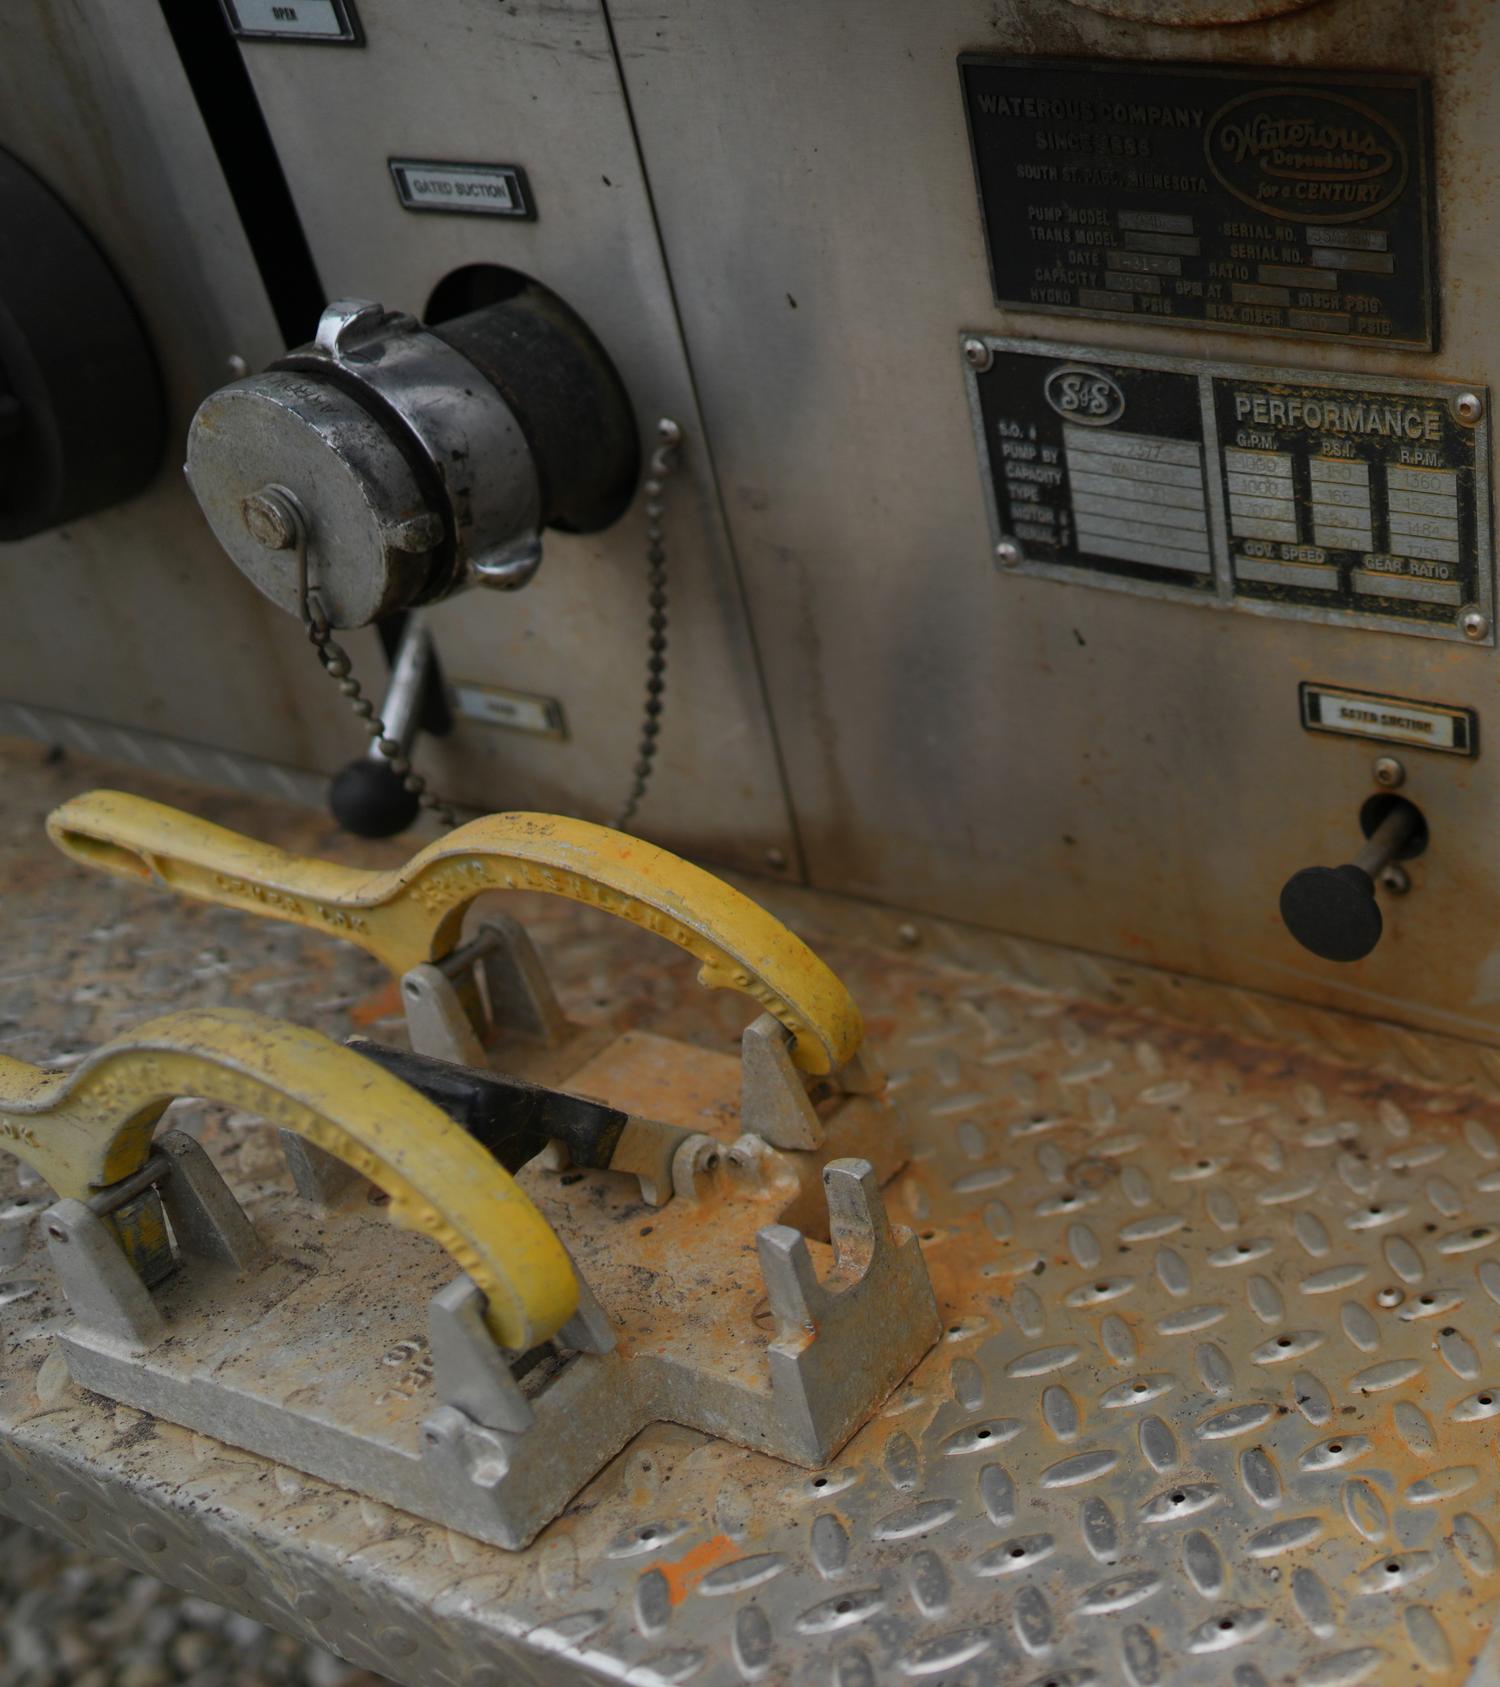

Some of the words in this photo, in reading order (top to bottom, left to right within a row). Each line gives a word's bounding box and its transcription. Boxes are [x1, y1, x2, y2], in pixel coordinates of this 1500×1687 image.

[977, 93, 1095, 120] WATEROUS
[1099, 101, 1204, 128] COMPANY
[1220, 113, 1378, 163] Waterous
[1273, 149, 1369, 170] Dependable
[1016, 163, 1058, 181] SOUTH
[454, 183, 508, 199] SUCTION
[1256, 181, 1280, 201] for
[1294, 182, 1381, 202] CENTURY
[1027, 204, 1064, 222] PUMP
[1068, 207, 1112, 225] MODEL
[1074, 230, 1120, 248] MODEL
[1222, 222, 1273, 240] SERIAL
[1066, 249, 1100, 266] DATE
[1229, 242, 1281, 262] SERIAL
[1034, 266, 1098, 287] CAPACITY
[1206, 262, 1249, 281] RATIO
[1061, 377, 1110, 414] S&S
[1234, 392, 1442, 442] PERFORMANCE
[1002, 440, 1038, 462] PUMP
[1040, 445, 1060, 465] BY
[1004, 461, 1062, 487] CAPACITY
[1281, 546, 1326, 566] SPEED
[1364, 553, 1403, 575] GEAR
[1410, 560, 1450, 581] RATIO
